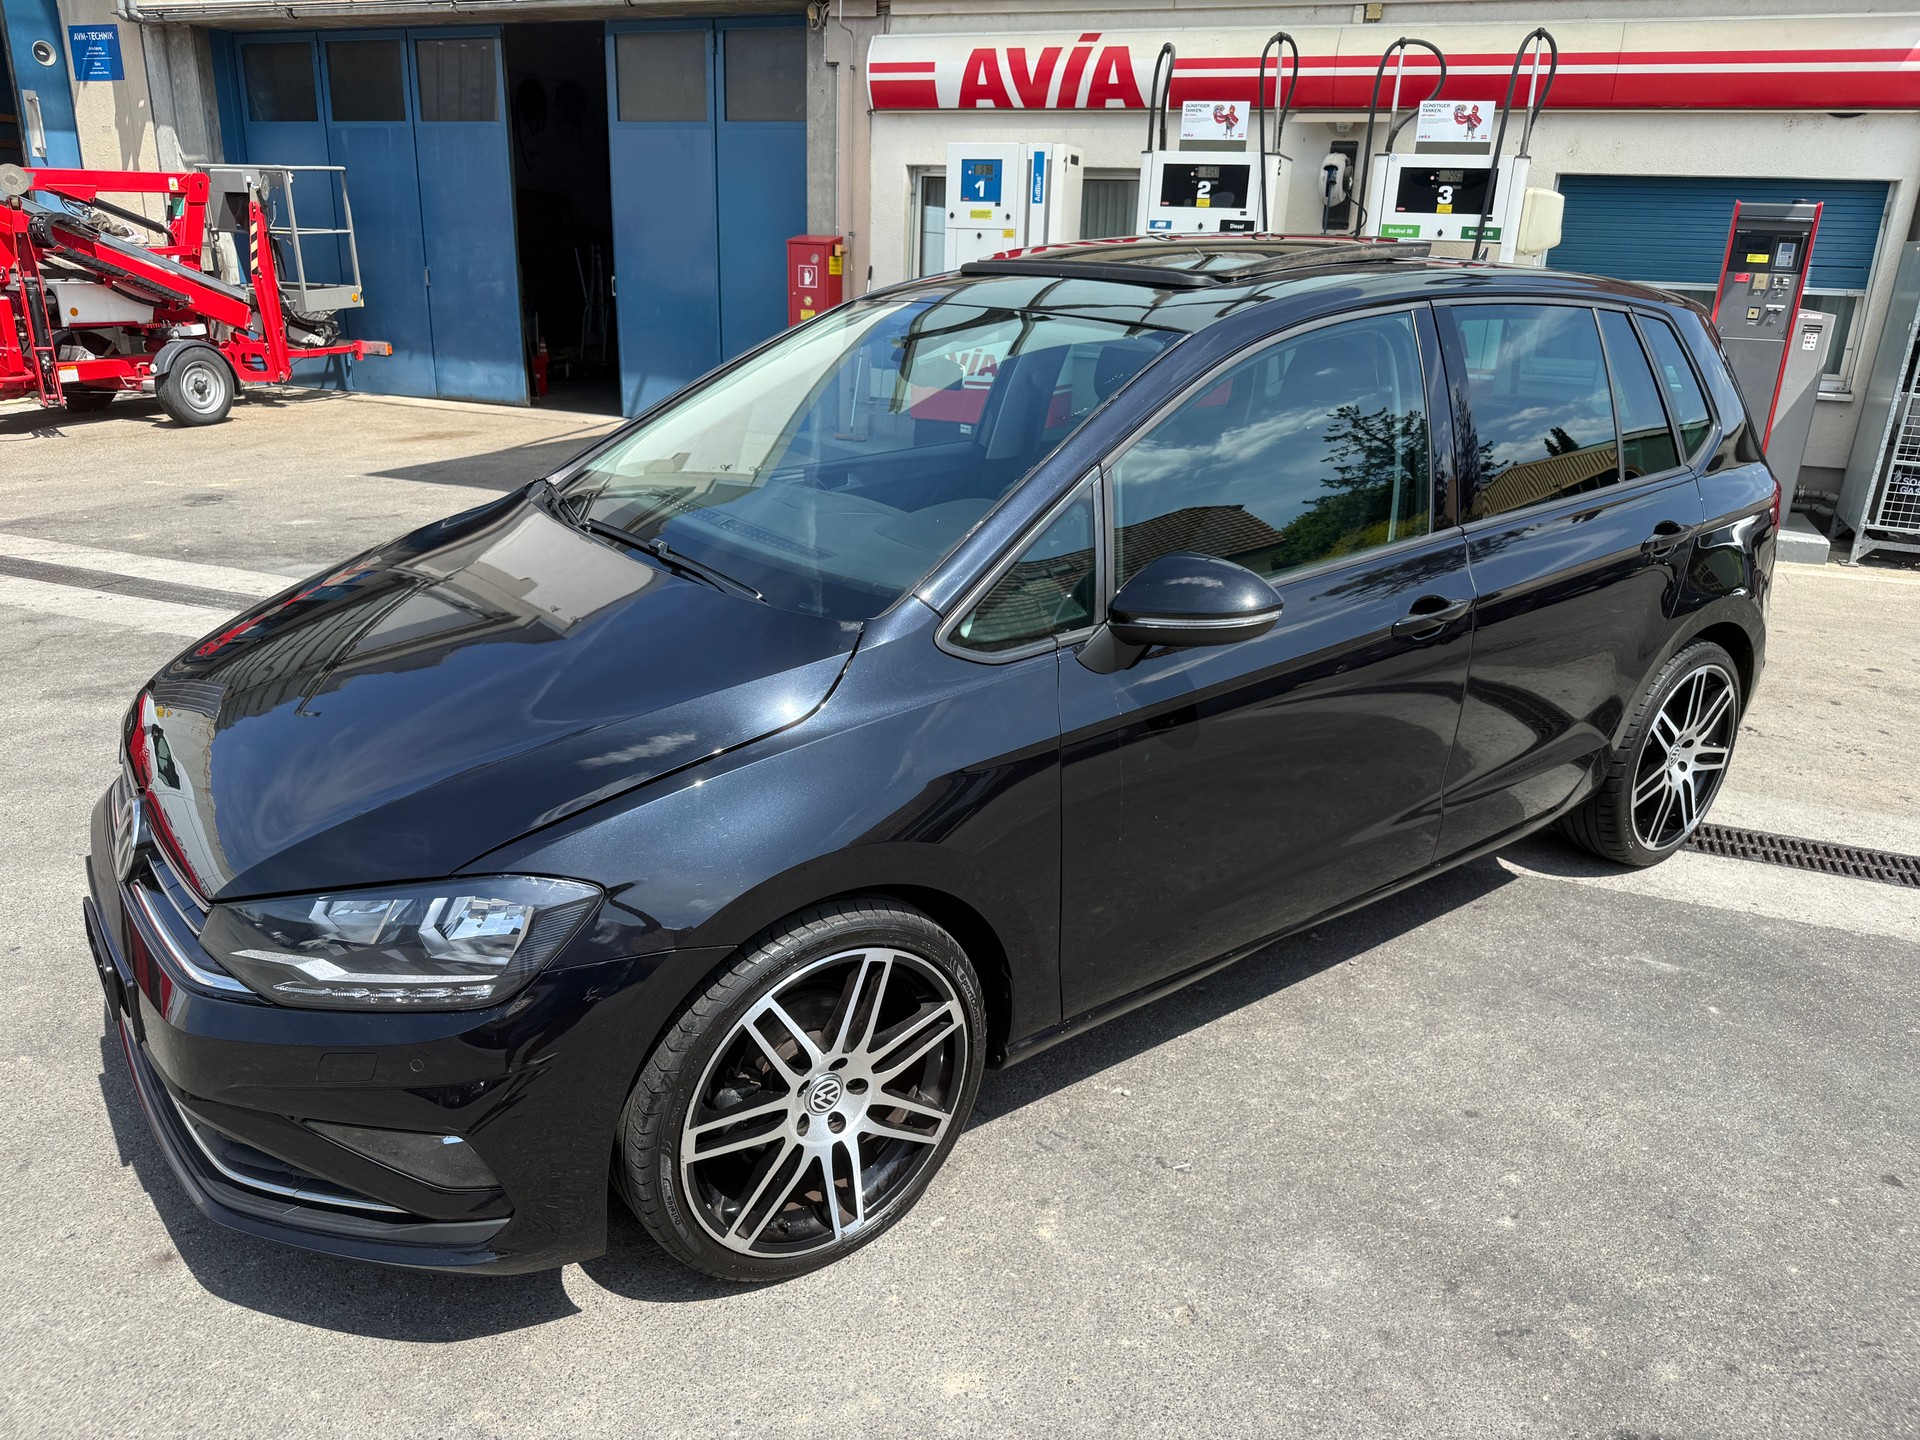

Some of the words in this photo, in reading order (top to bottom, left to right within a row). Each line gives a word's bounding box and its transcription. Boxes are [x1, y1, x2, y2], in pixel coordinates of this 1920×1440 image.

[958, 32, 1145, 108] AVIA
[974, 180, 985, 198] 1
[1196, 180, 1211, 199] 2
[1437, 185, 1453, 204] 3
